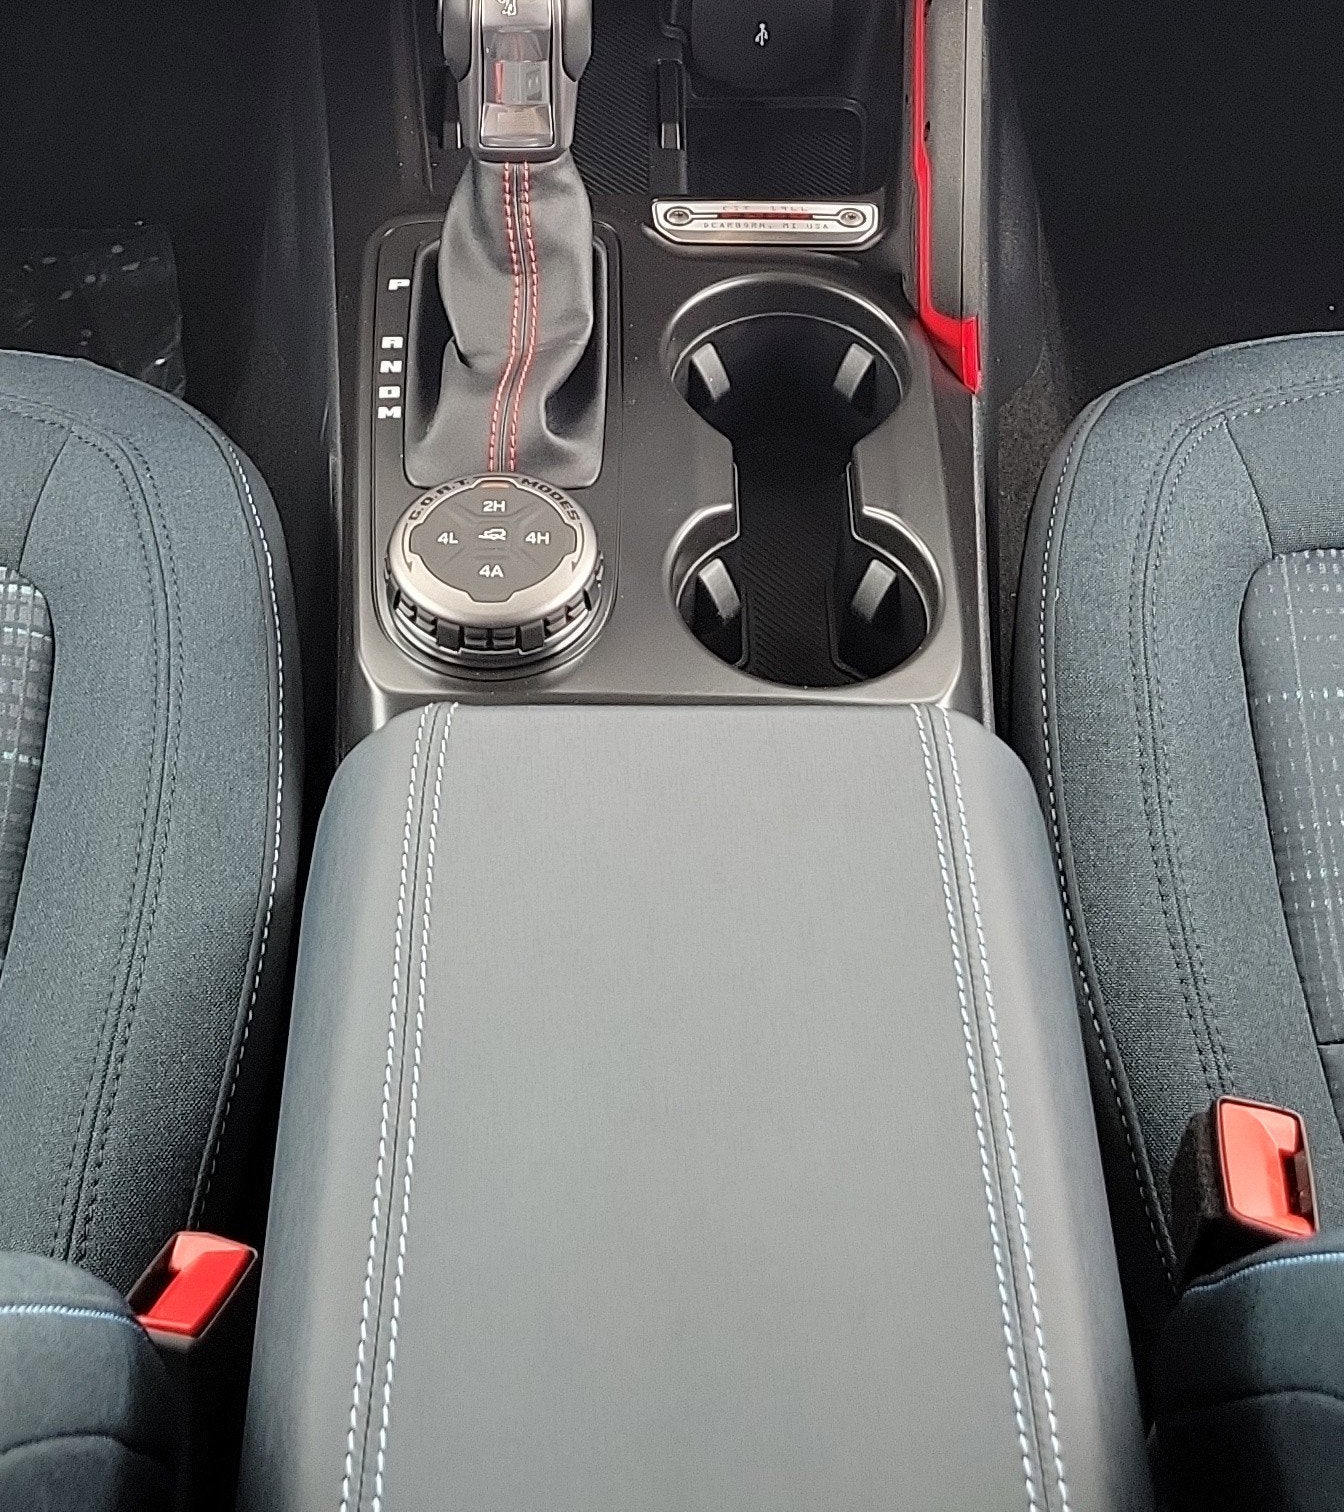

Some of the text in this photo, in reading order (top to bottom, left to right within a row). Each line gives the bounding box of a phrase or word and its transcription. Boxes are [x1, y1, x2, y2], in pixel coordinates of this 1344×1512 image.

[388, 278, 410, 291] P
[381, 336, 403, 349] R
[379, 361, 402, 373] N
[378, 386, 401, 399] D
[378, 407, 401, 419] M
[483, 500, 506, 512] 2H
[521, 478, 581, 521] MODES
[437, 532, 550, 544] 4L 4H
[479, 565, 504, 578] 4A
